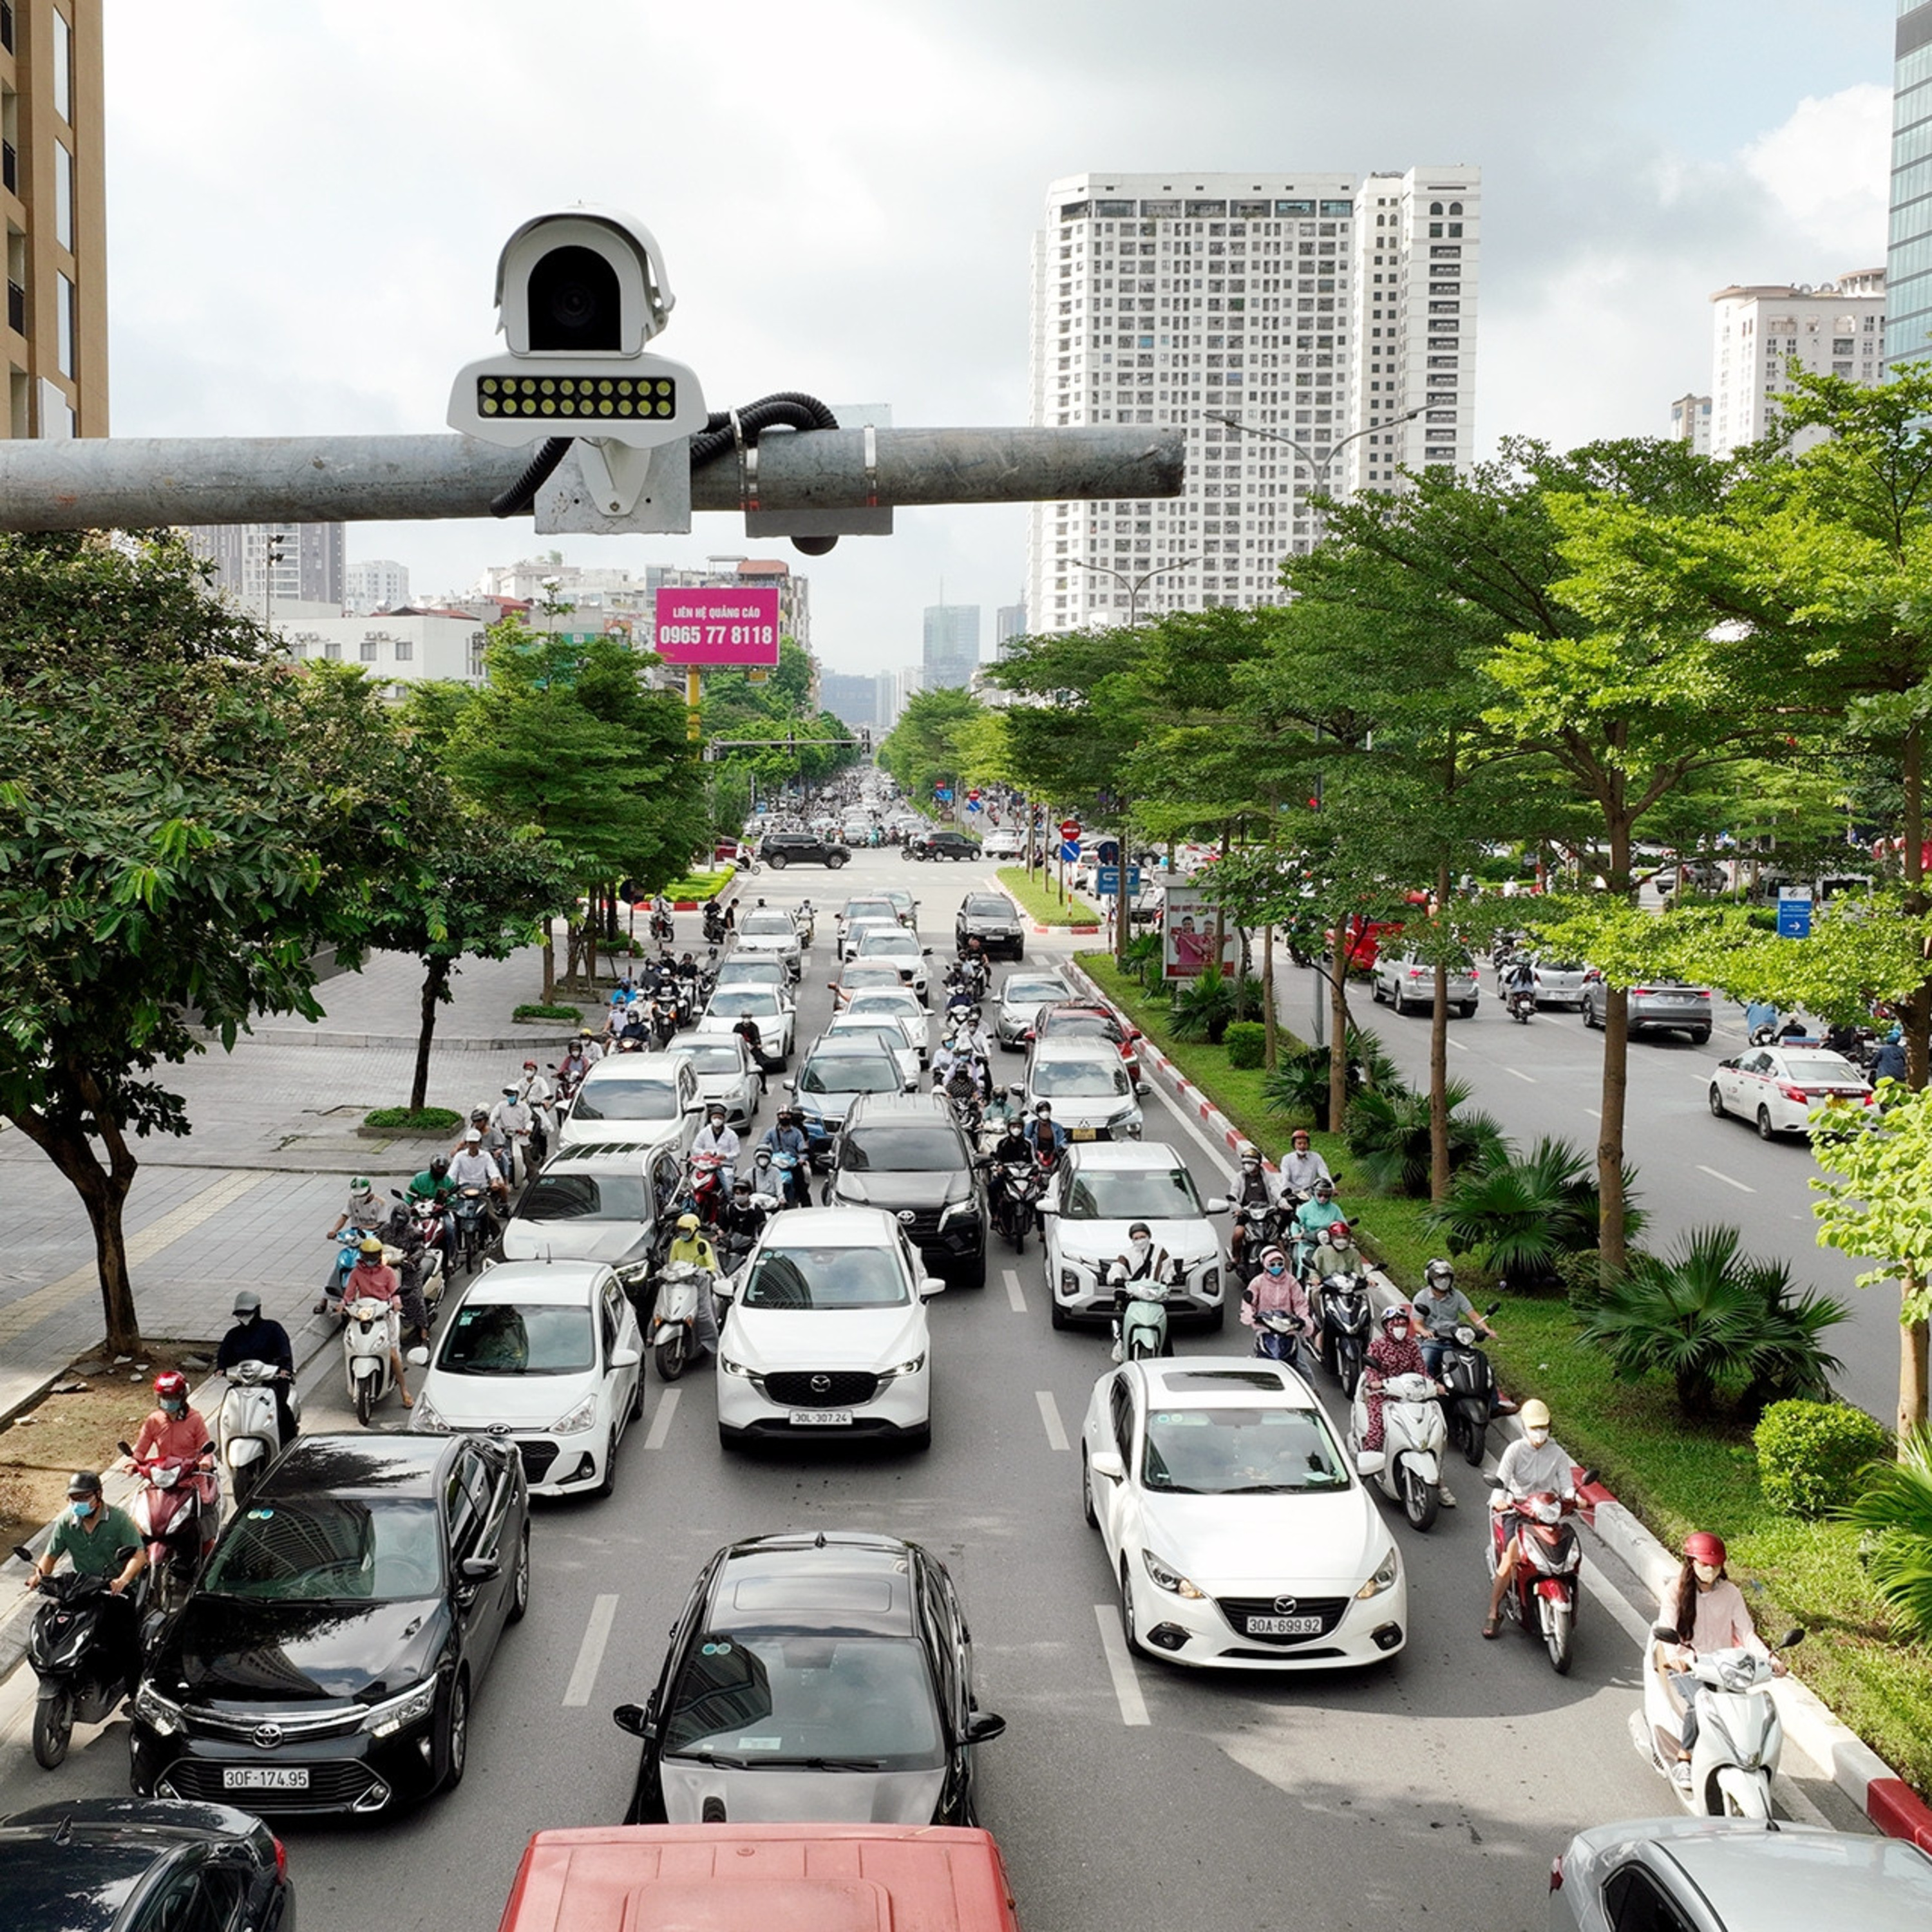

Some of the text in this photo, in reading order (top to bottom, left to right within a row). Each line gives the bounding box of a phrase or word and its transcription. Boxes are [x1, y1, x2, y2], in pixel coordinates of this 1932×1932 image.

[673, 605, 761, 620] LIÊN HỆ QUẢNG CÁO
[660, 625, 772, 644] 0965 77 8118
[1249, 1618, 1320, 1632] 30A-699.92
[226, 1772, 307, 1786] 30F-174.95
